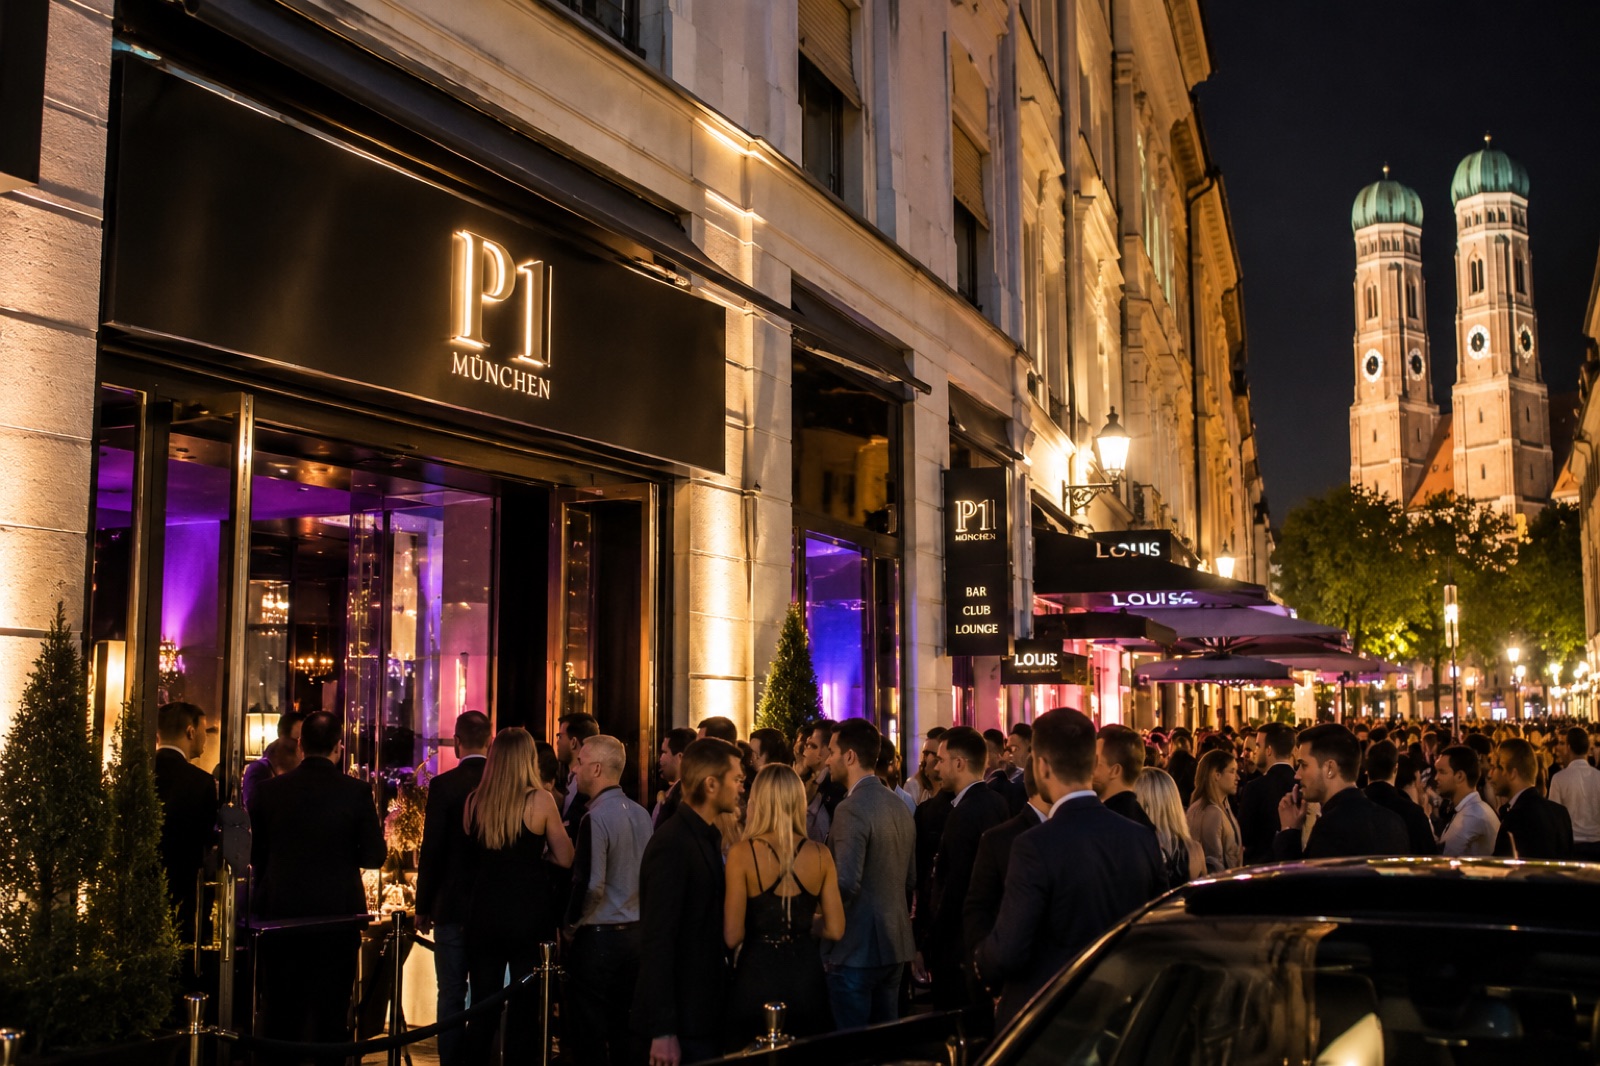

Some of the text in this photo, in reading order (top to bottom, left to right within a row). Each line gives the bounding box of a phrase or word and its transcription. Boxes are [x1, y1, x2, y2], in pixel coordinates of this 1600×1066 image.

[450, 229, 552, 368] P1
[451, 352, 551, 400] MÜNCHEN
[955, 499, 997, 533] P1
[966, 586, 987, 598] BAR
[962, 605, 991, 616] CLUB
[955, 623, 999, 635] LOUNGE
